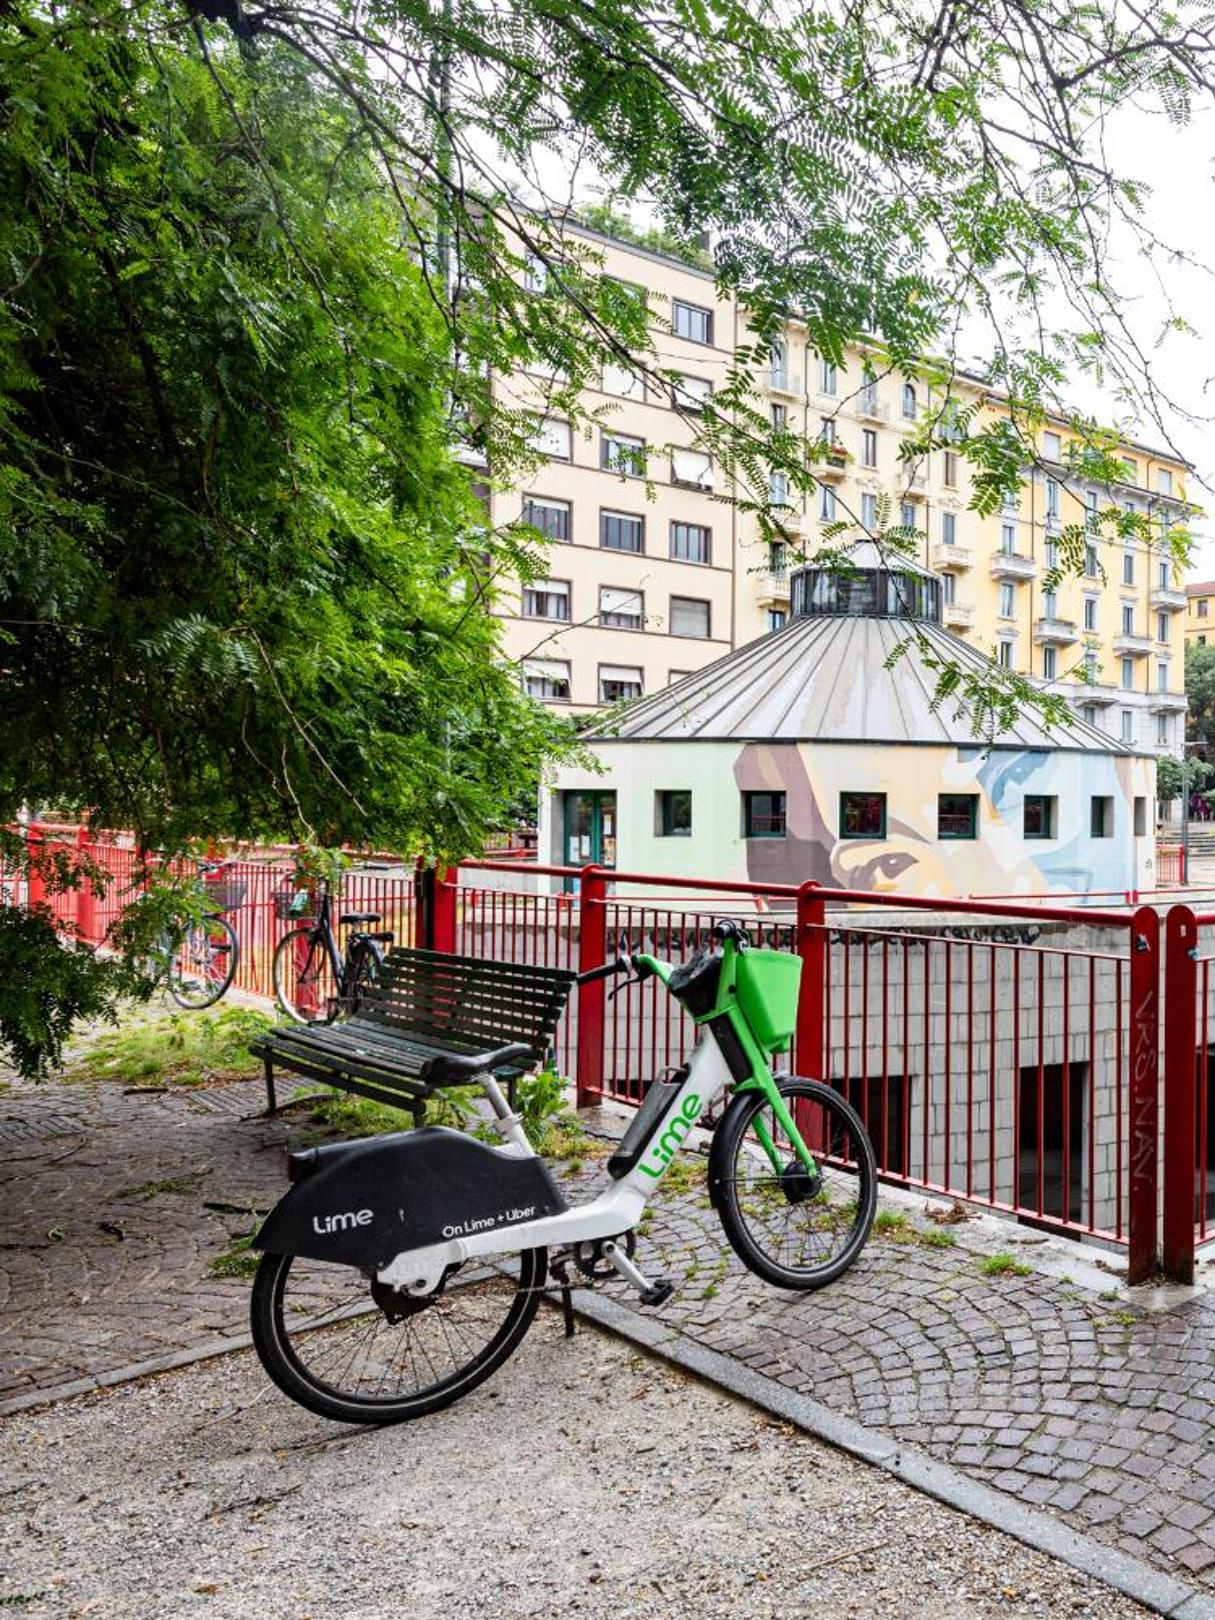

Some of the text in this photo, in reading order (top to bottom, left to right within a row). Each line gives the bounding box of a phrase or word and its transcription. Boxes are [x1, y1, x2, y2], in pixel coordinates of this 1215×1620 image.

[637, 1093, 702, 1178] Lime
[312, 1208, 375, 1235] Lime
[442, 1224, 463, 1238] On
[464, 1216, 495, 1232] Lime
[505, 1205, 536, 1222] Uber
